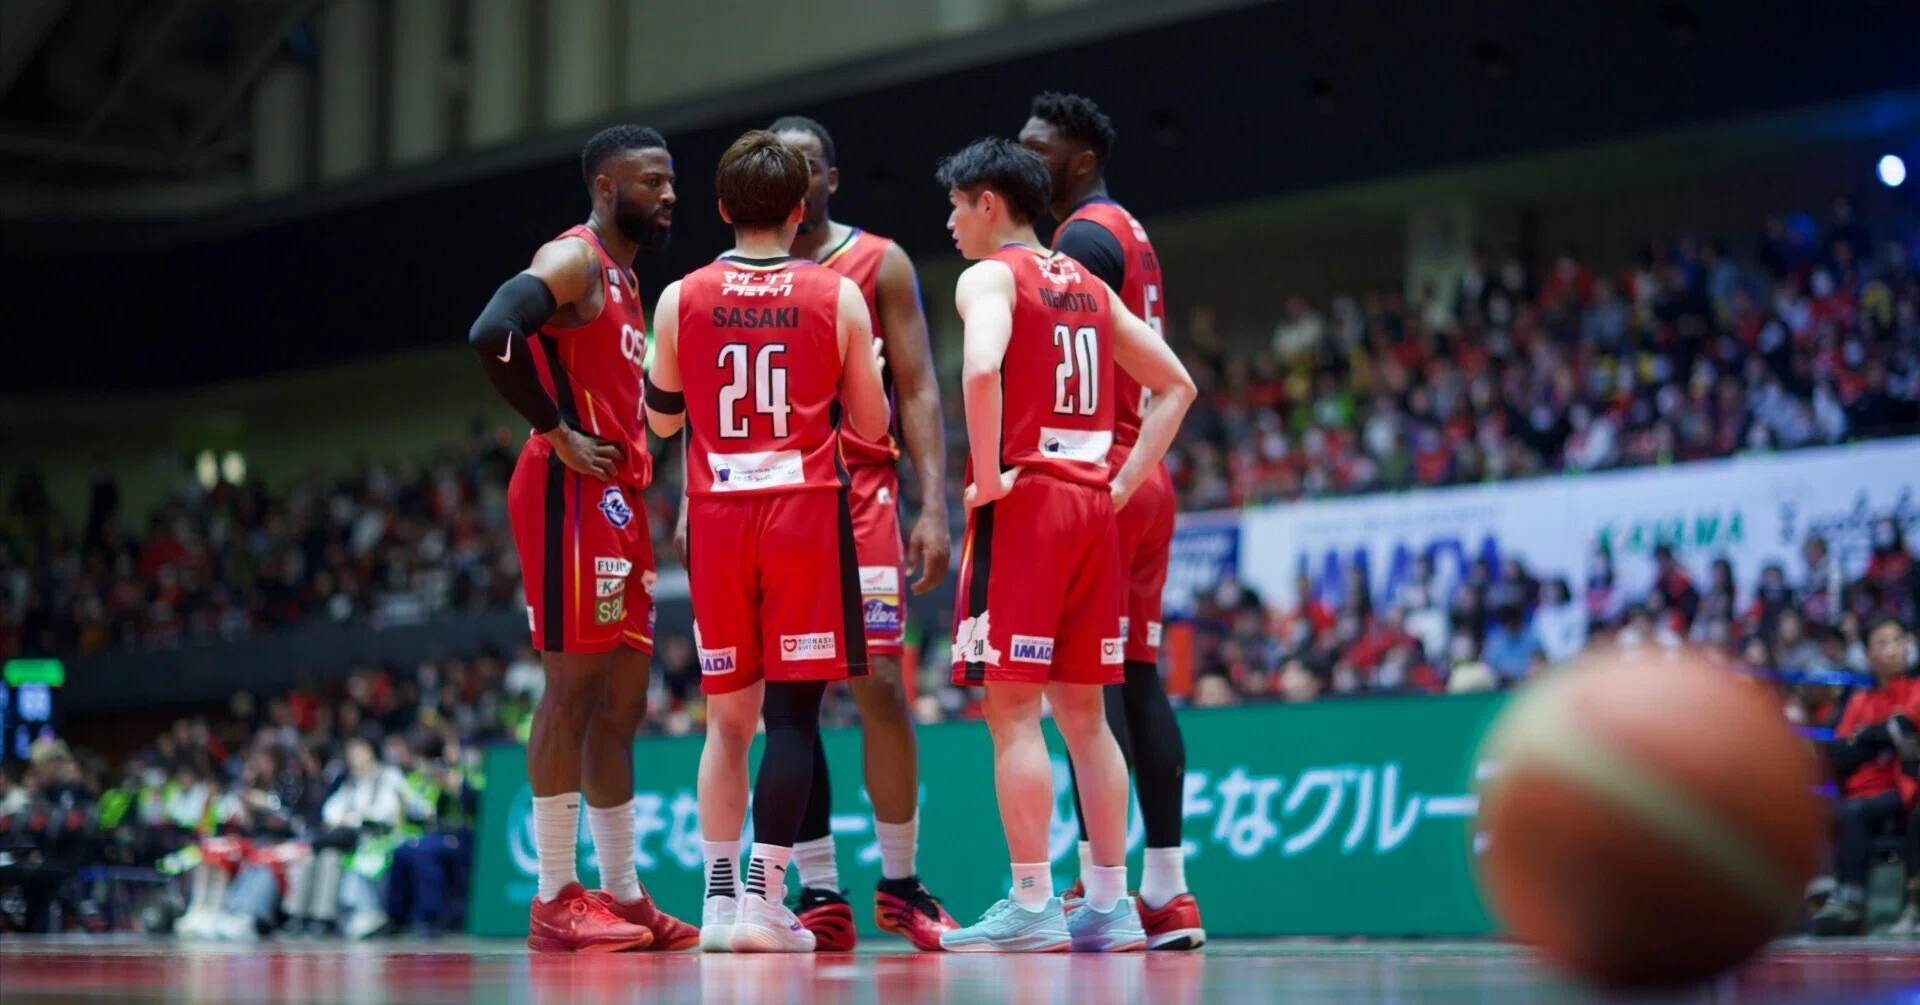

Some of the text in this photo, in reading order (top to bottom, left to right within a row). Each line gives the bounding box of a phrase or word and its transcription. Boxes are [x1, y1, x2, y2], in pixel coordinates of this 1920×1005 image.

[1038, 287, 1098, 313] NEMOTO
[712, 305, 799, 328] SASAKI
[620, 323, 648, 366] OS
[1052, 323, 1099, 417] 20
[716, 341, 792, 439] 24
[974, 639, 984, 656] 20
[702, 656, 734, 671] ADA
